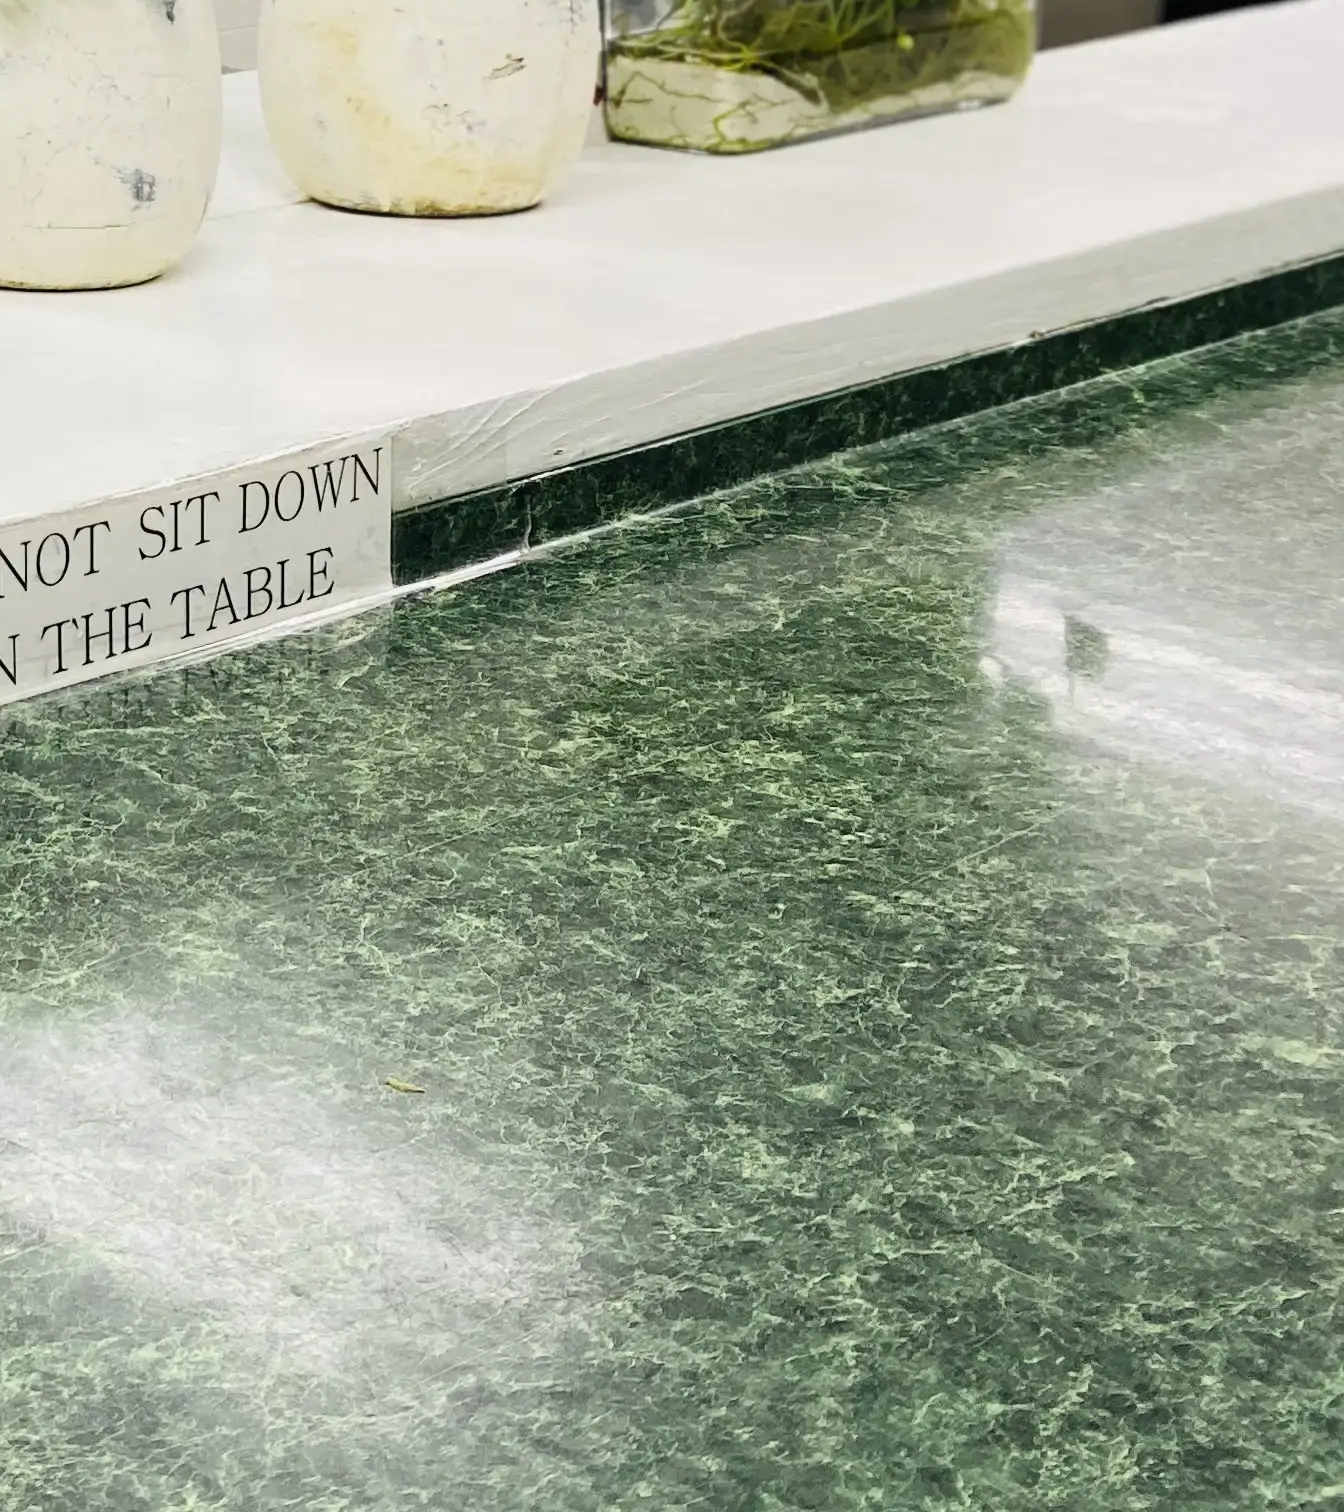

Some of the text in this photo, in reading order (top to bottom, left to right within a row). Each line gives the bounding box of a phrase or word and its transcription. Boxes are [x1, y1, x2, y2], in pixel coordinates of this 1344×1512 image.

[138, 491, 221, 561] SIT
[238, 447, 383, 534] DOWN
[40, 597, 153, 676] THE
[170, 546, 335, 640] TABLE
